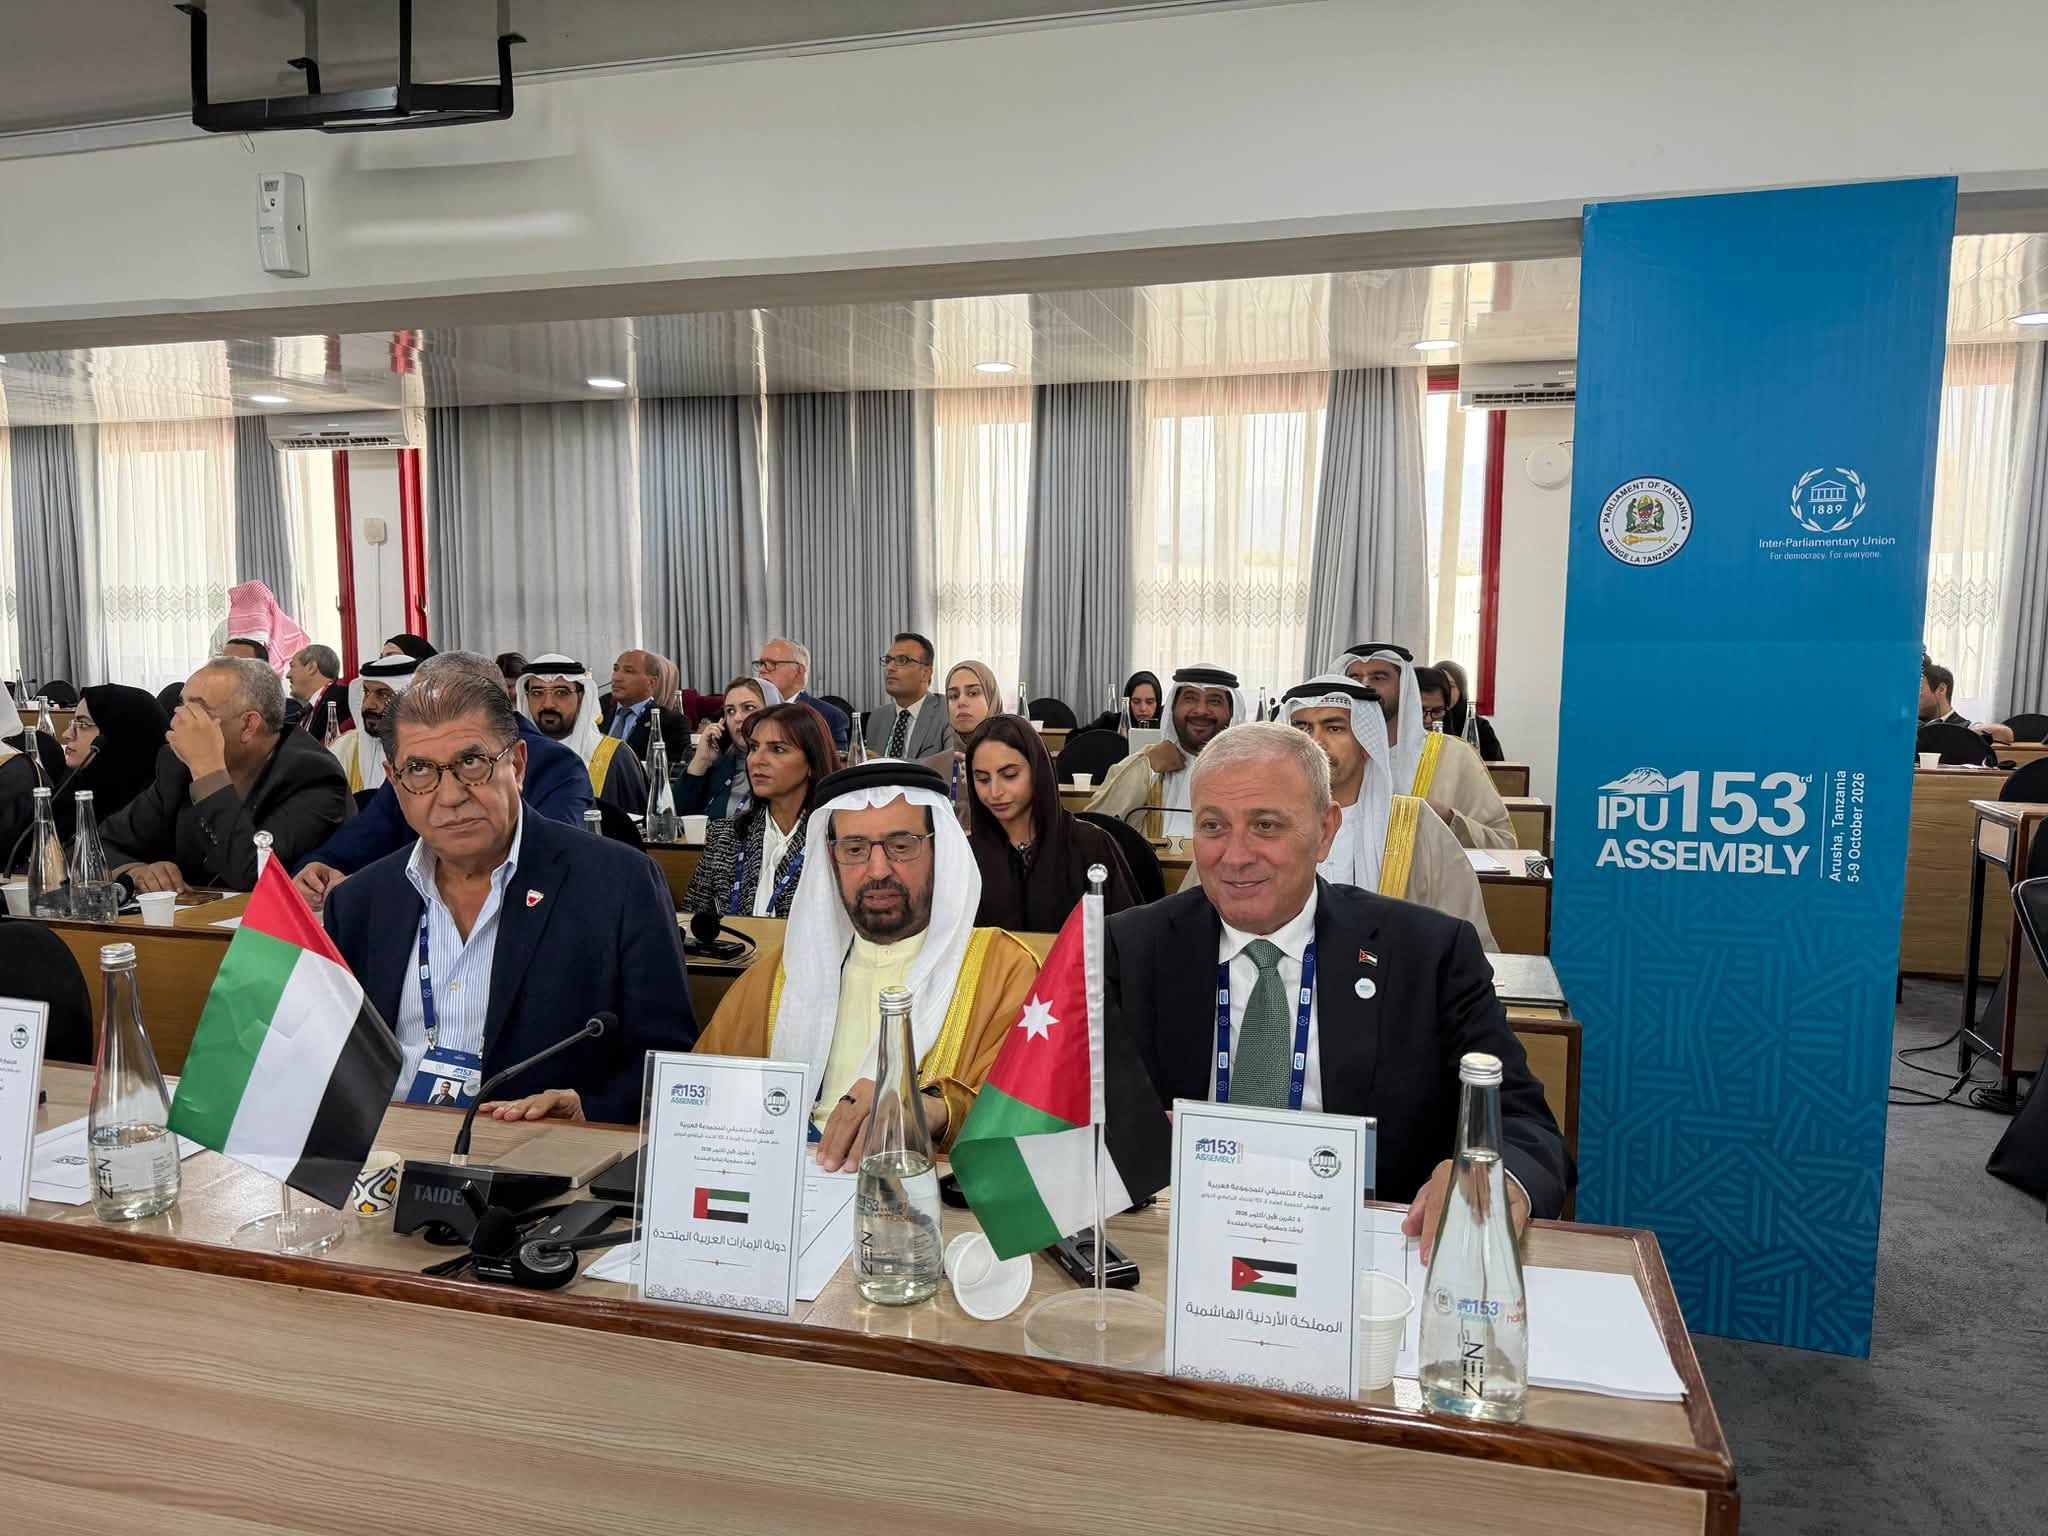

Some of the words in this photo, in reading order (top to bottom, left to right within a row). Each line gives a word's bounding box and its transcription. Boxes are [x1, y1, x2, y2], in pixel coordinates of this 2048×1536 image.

[1603, 481, 1644, 523] PARLIAMENT
[1647, 481, 1661, 489] OF
[1662, 484, 1688, 522] TANZANIA
[1812, 504, 1843, 515] 1889
[1607, 539, 1629, 561] BUNGE
[1630, 555, 1640, 563] LA
[1642, 542, 1680, 563] TANZANIA
[1759, 537, 1859, 548] Inter-Parliamentary
[1862, 536, 1896, 546] Union
[1770, 552, 1783, 561] For
[1829, 550, 1841, 559] For
[1851, 772, 1865, 803] 2026
[1832, 770, 1847, 828] Tanzania
[1597, 795, 1669, 832] IPU
[1848, 807, 1863, 860] October
[1596, 838, 1810, 875] ASSEMBLY
[1829, 832, 1845, 882] Arusha,
[1847, 863, 1860, 882] 5-9
[1195, 1143, 1210, 1154] IPU
[1209, 1139, 1237, 1155] 153
[1195, 1152, 1236, 1165] ASSEMBLY
[413, 1184, 464, 1206] TAIDE
[653, 1228, 692, 1242] المتحدة
[693, 1231, 726, 1246] العربية
[727, 1236, 763, 1251] الإمارات
[764, 1239, 787, 1253] دولة
[1185, 1301, 1244, 1321] الهاشمية
[1245, 1308, 1288, 1327] الأردنية
[1472, 1300, 1499, 1316] 153
[1290, 1314, 1343, 1334] المملكة
